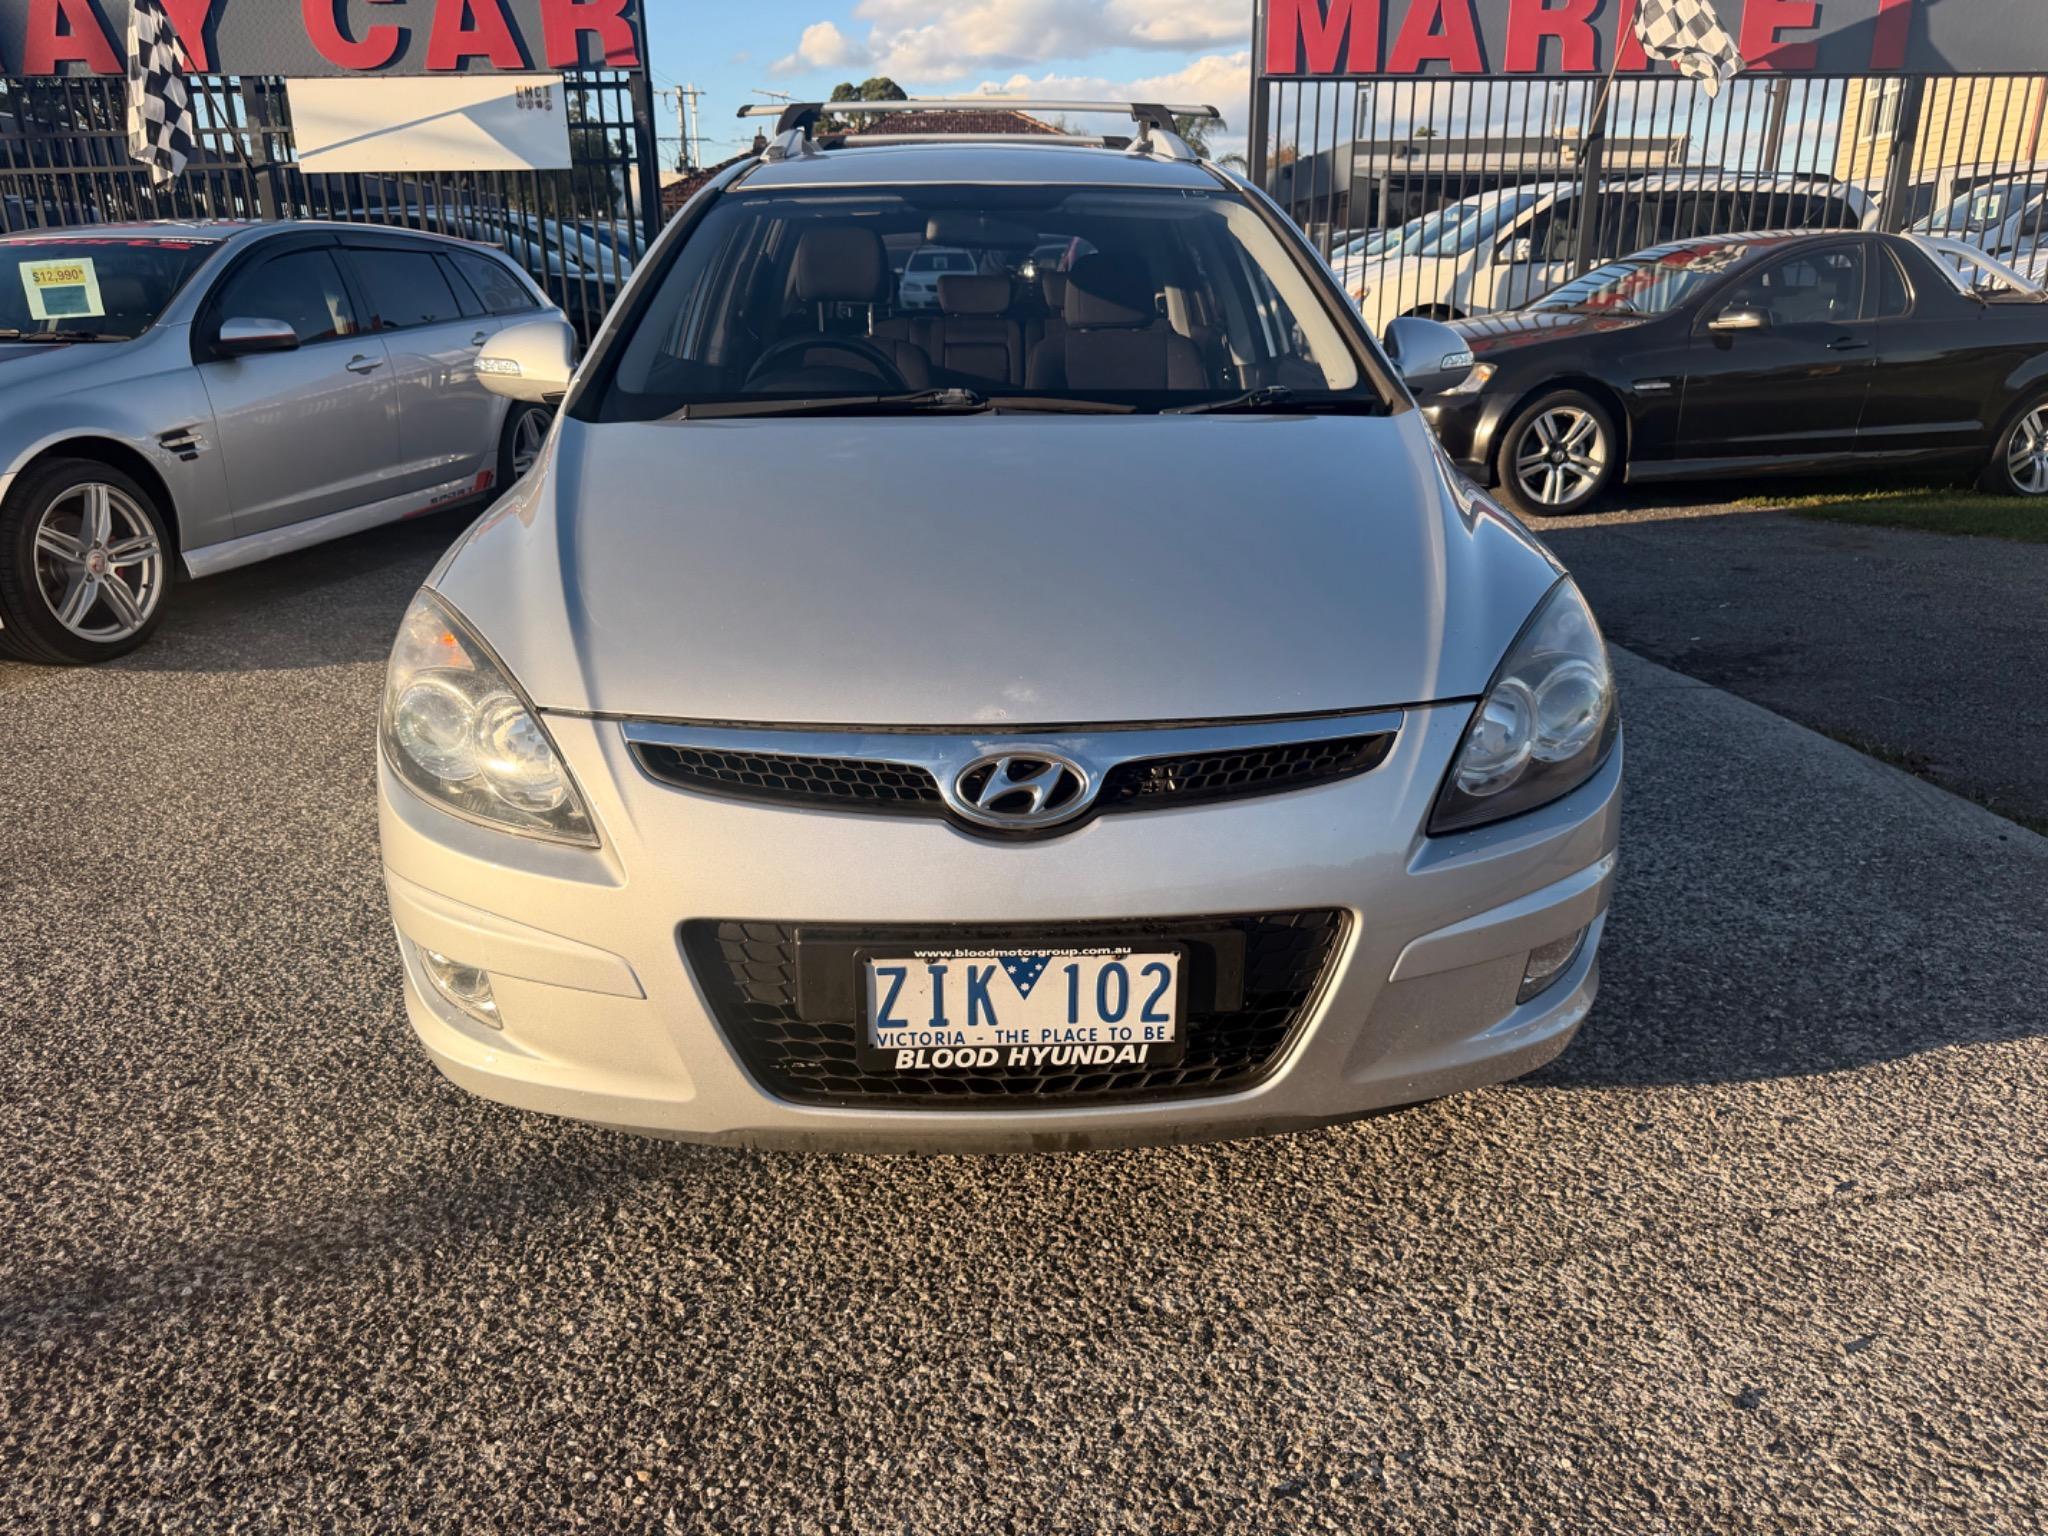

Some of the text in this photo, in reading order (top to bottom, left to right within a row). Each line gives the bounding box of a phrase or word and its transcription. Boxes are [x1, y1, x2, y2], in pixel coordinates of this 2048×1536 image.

[302, 0, 639, 70] CAR
[913, 946, 1132, 958] www.bloodmotorgroup.com.au
[876, 962, 1171, 1029] ZIK 102
[876, 1031, 966, 1047] VICTORIA
[995, 1029, 1030, 1044] THE
[1041, 1027, 1098, 1043] PLACE
[1109, 1026, 1132, 1041] TO
[1144, 1025, 1166, 1041] BE
[895, 1044, 1149, 1070] BLOOD HYUNDAI
